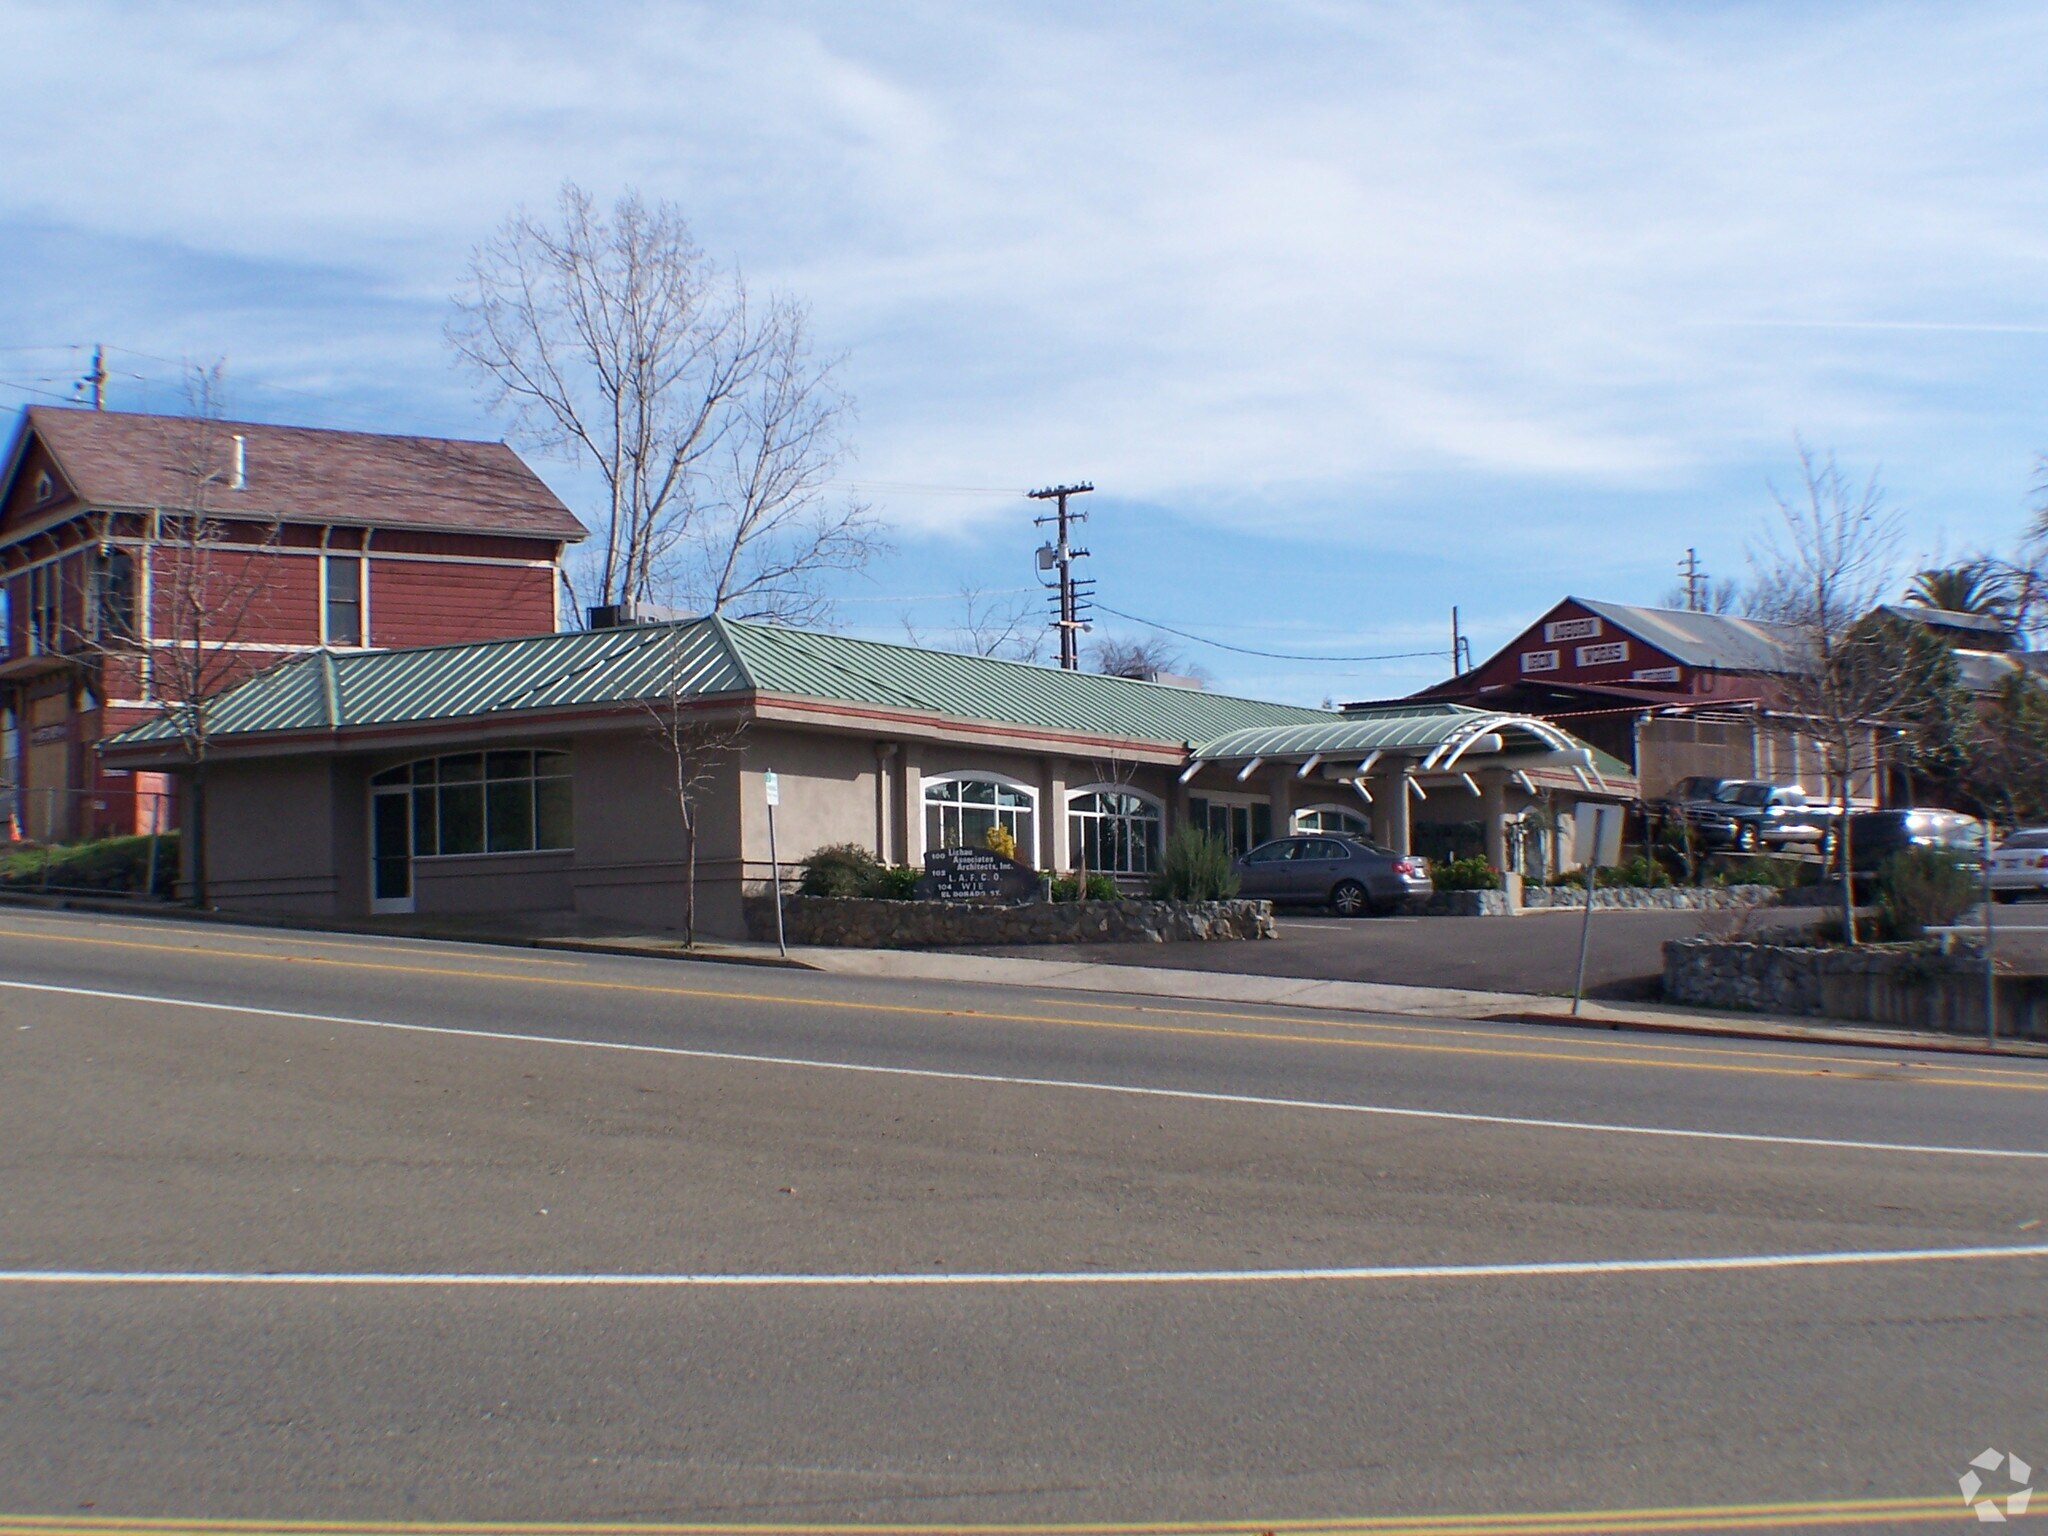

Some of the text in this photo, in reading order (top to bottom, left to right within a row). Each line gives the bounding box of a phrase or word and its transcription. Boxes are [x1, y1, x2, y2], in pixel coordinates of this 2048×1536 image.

[953, 855, 994, 863] Associates
[957, 862, 1014, 871] Architects, Inc.
